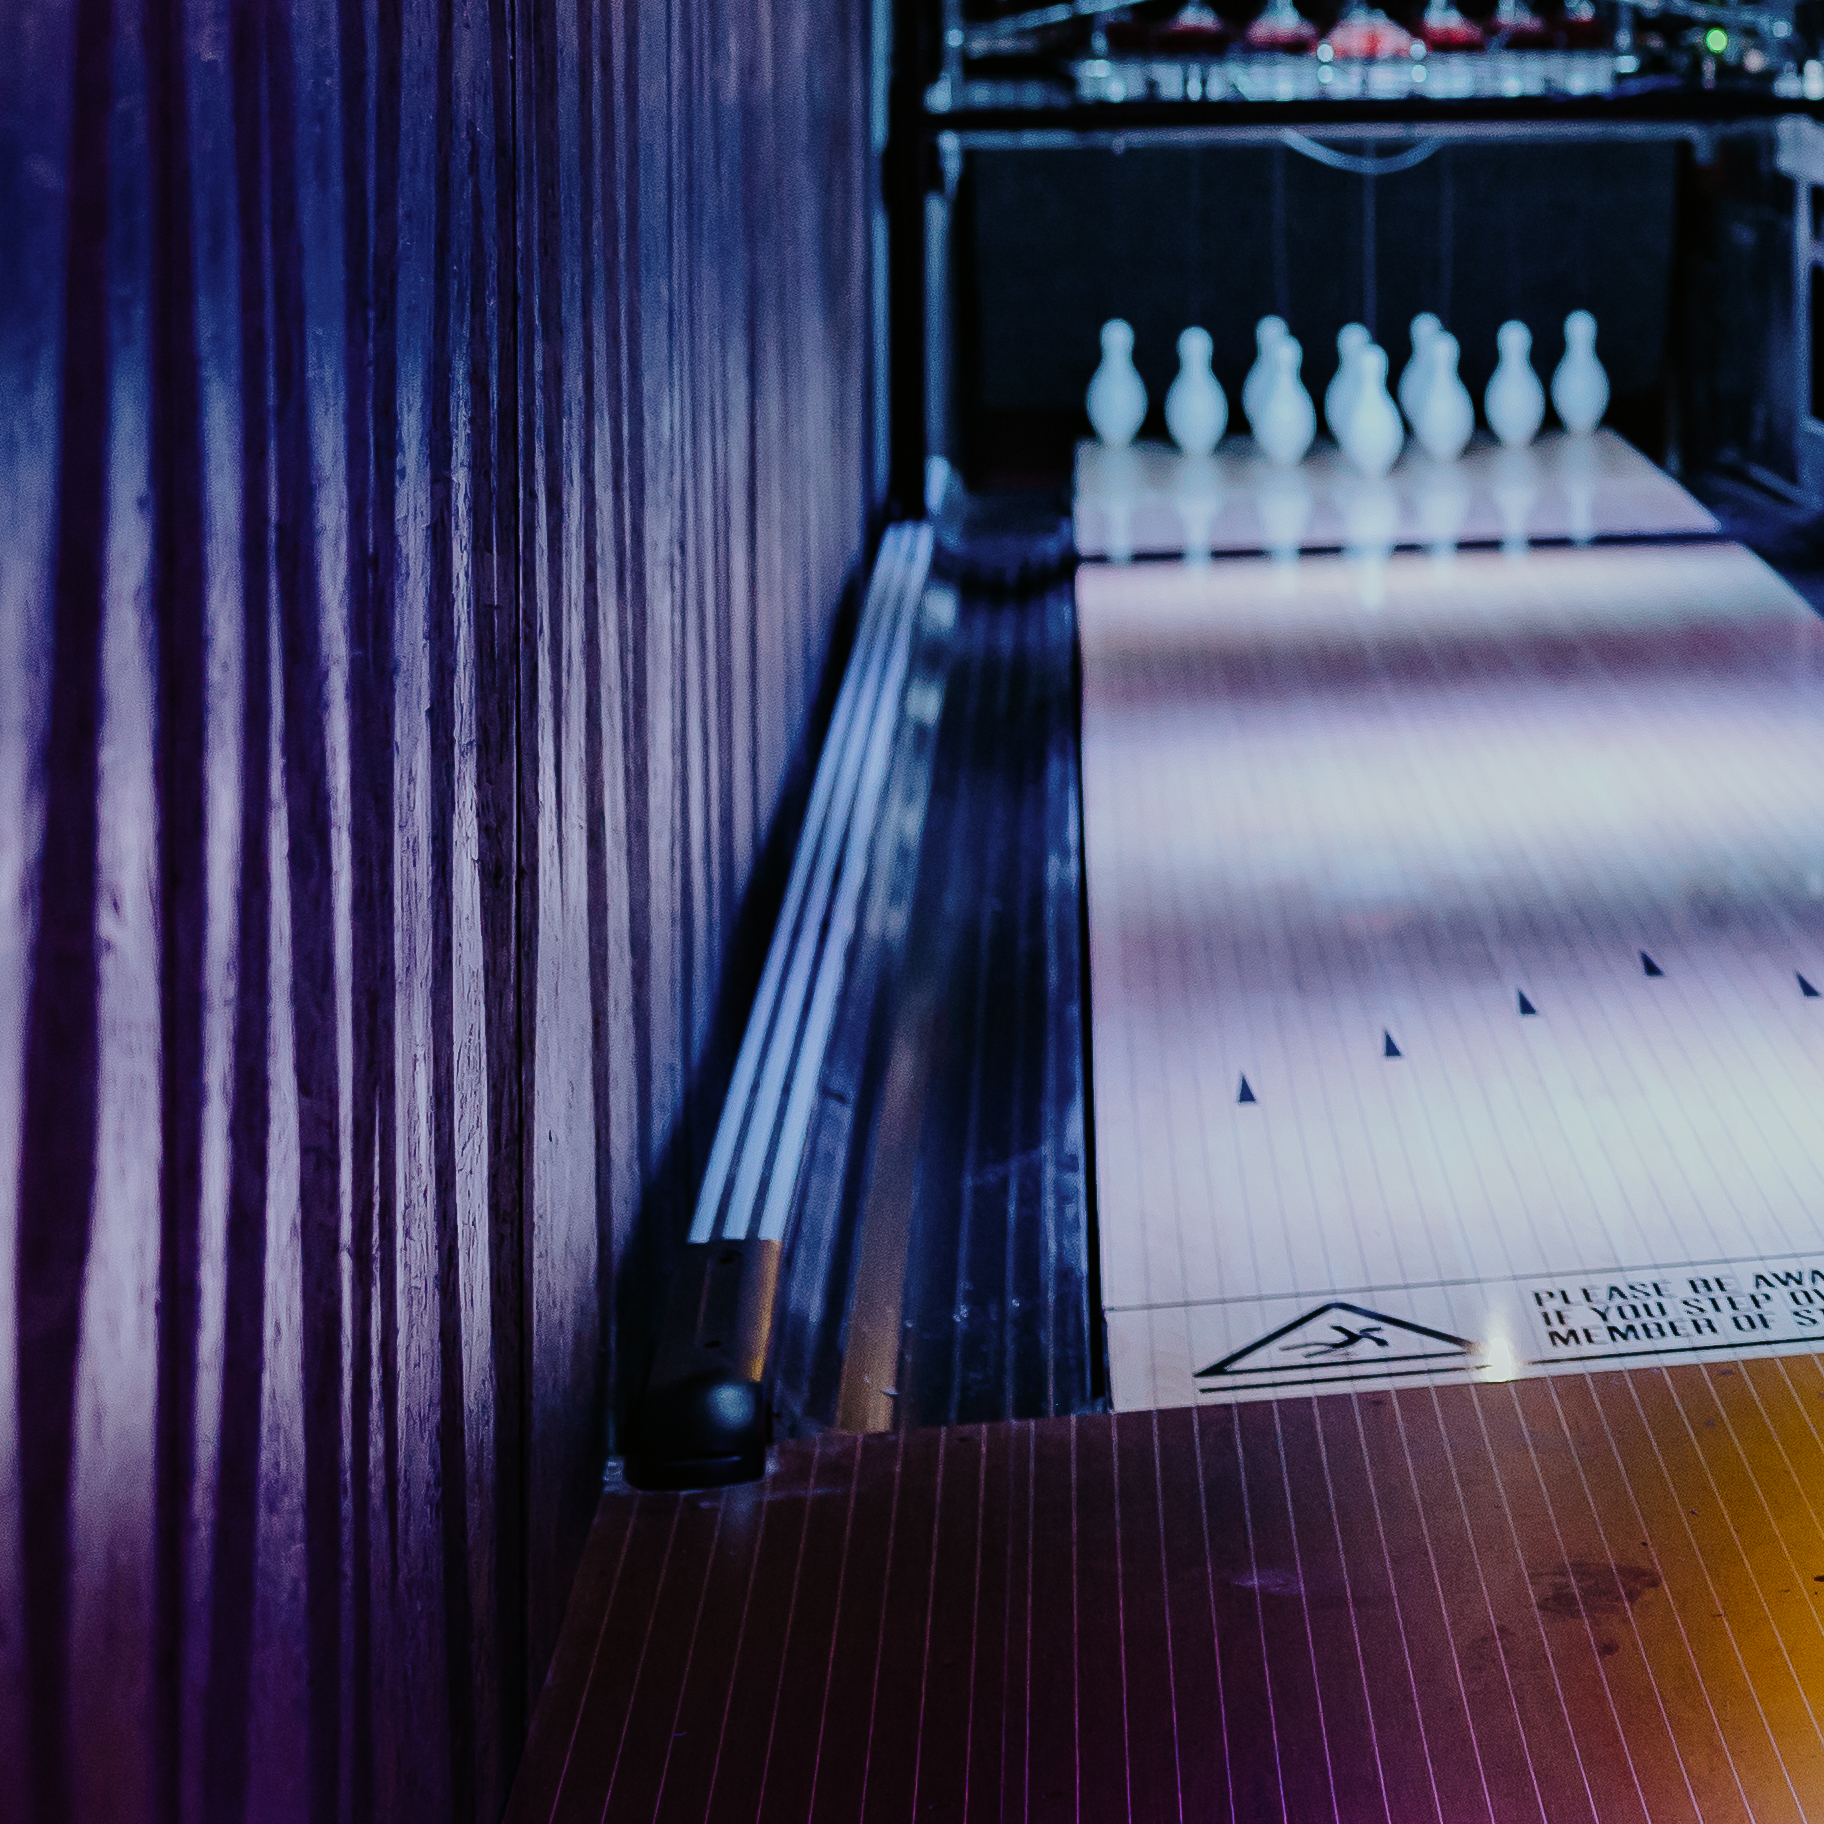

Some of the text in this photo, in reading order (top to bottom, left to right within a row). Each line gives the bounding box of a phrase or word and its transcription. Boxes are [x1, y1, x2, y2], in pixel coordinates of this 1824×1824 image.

[1534, 1281, 1669, 1307] PLEASE
[1688, 1276, 1733, 1294] BE
[1541, 1307, 1571, 1327] IF
[1590, 1300, 1668, 1323] YOU
[1682, 1292, 1772, 1315] STEP
[1547, 1318, 1718, 1347] MEMBER
[1732, 1312, 1776, 1333] OF
